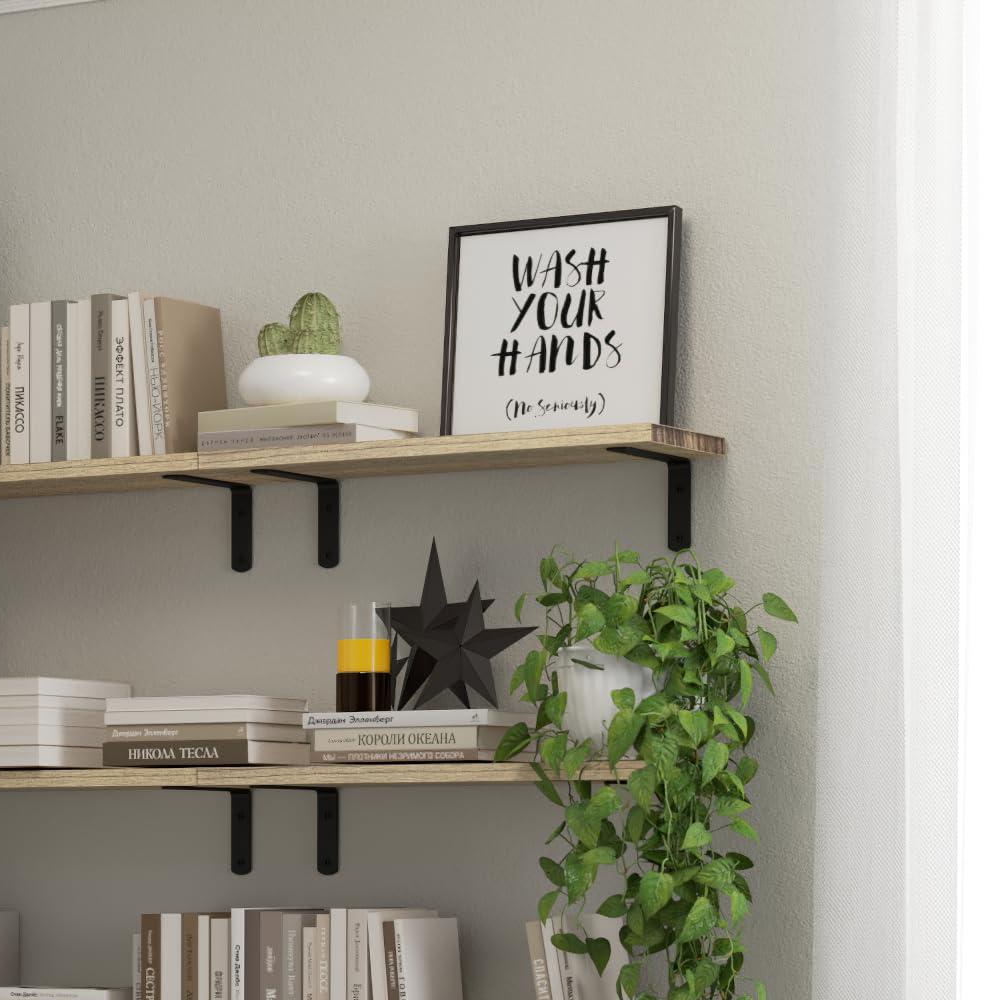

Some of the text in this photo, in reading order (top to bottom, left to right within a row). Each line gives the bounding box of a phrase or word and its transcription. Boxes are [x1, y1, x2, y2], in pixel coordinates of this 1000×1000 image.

[512, 247, 610, 292] WASH
[510, 288, 606, 333] YOUR
[490, 329, 623, 377] HANDS
[115, 336, 124, 427] ЭФФЕКТ ПЛАТО
[150, 366, 163, 441] НЬЮ-ЙОРК
[14, 386, 25, 434] ПИКАССО
[55, 414, 64, 445] FLAKE
[94, 375, 105, 442] ПИКАССО
[348, 714, 394, 724] Элленберг
[357, 733, 405, 746] КОРОЛИ
[408, 732, 456, 745] ОКЕАНА
[128, 746, 219, 760] НИКОЛА ТЕСЛА
